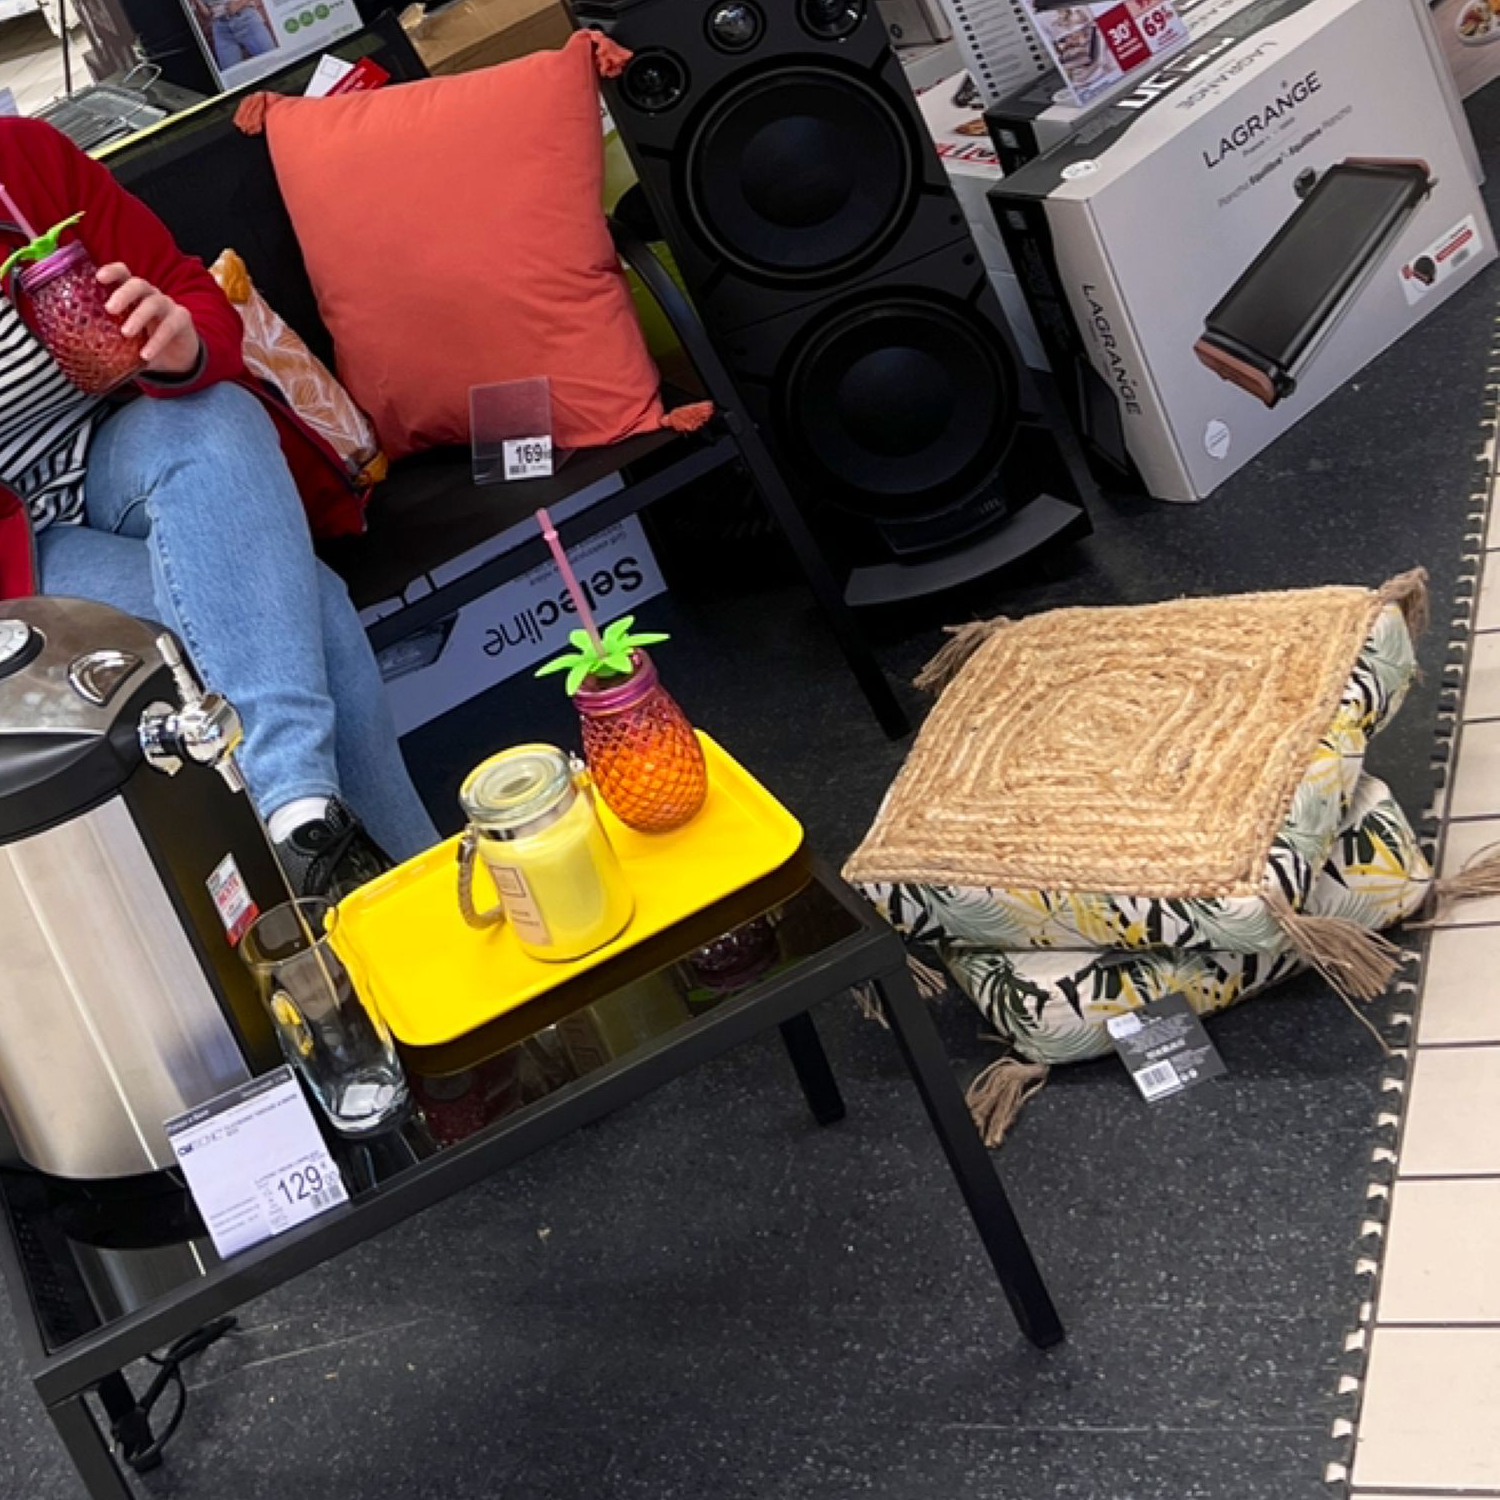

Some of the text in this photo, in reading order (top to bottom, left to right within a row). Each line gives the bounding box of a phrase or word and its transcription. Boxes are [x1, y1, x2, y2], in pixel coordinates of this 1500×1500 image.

[1202, 70, 1322, 169] LAGRANGE
[1082, 283, 1142, 418] LAGRANGE
[482, 556, 643, 657] Selecline
